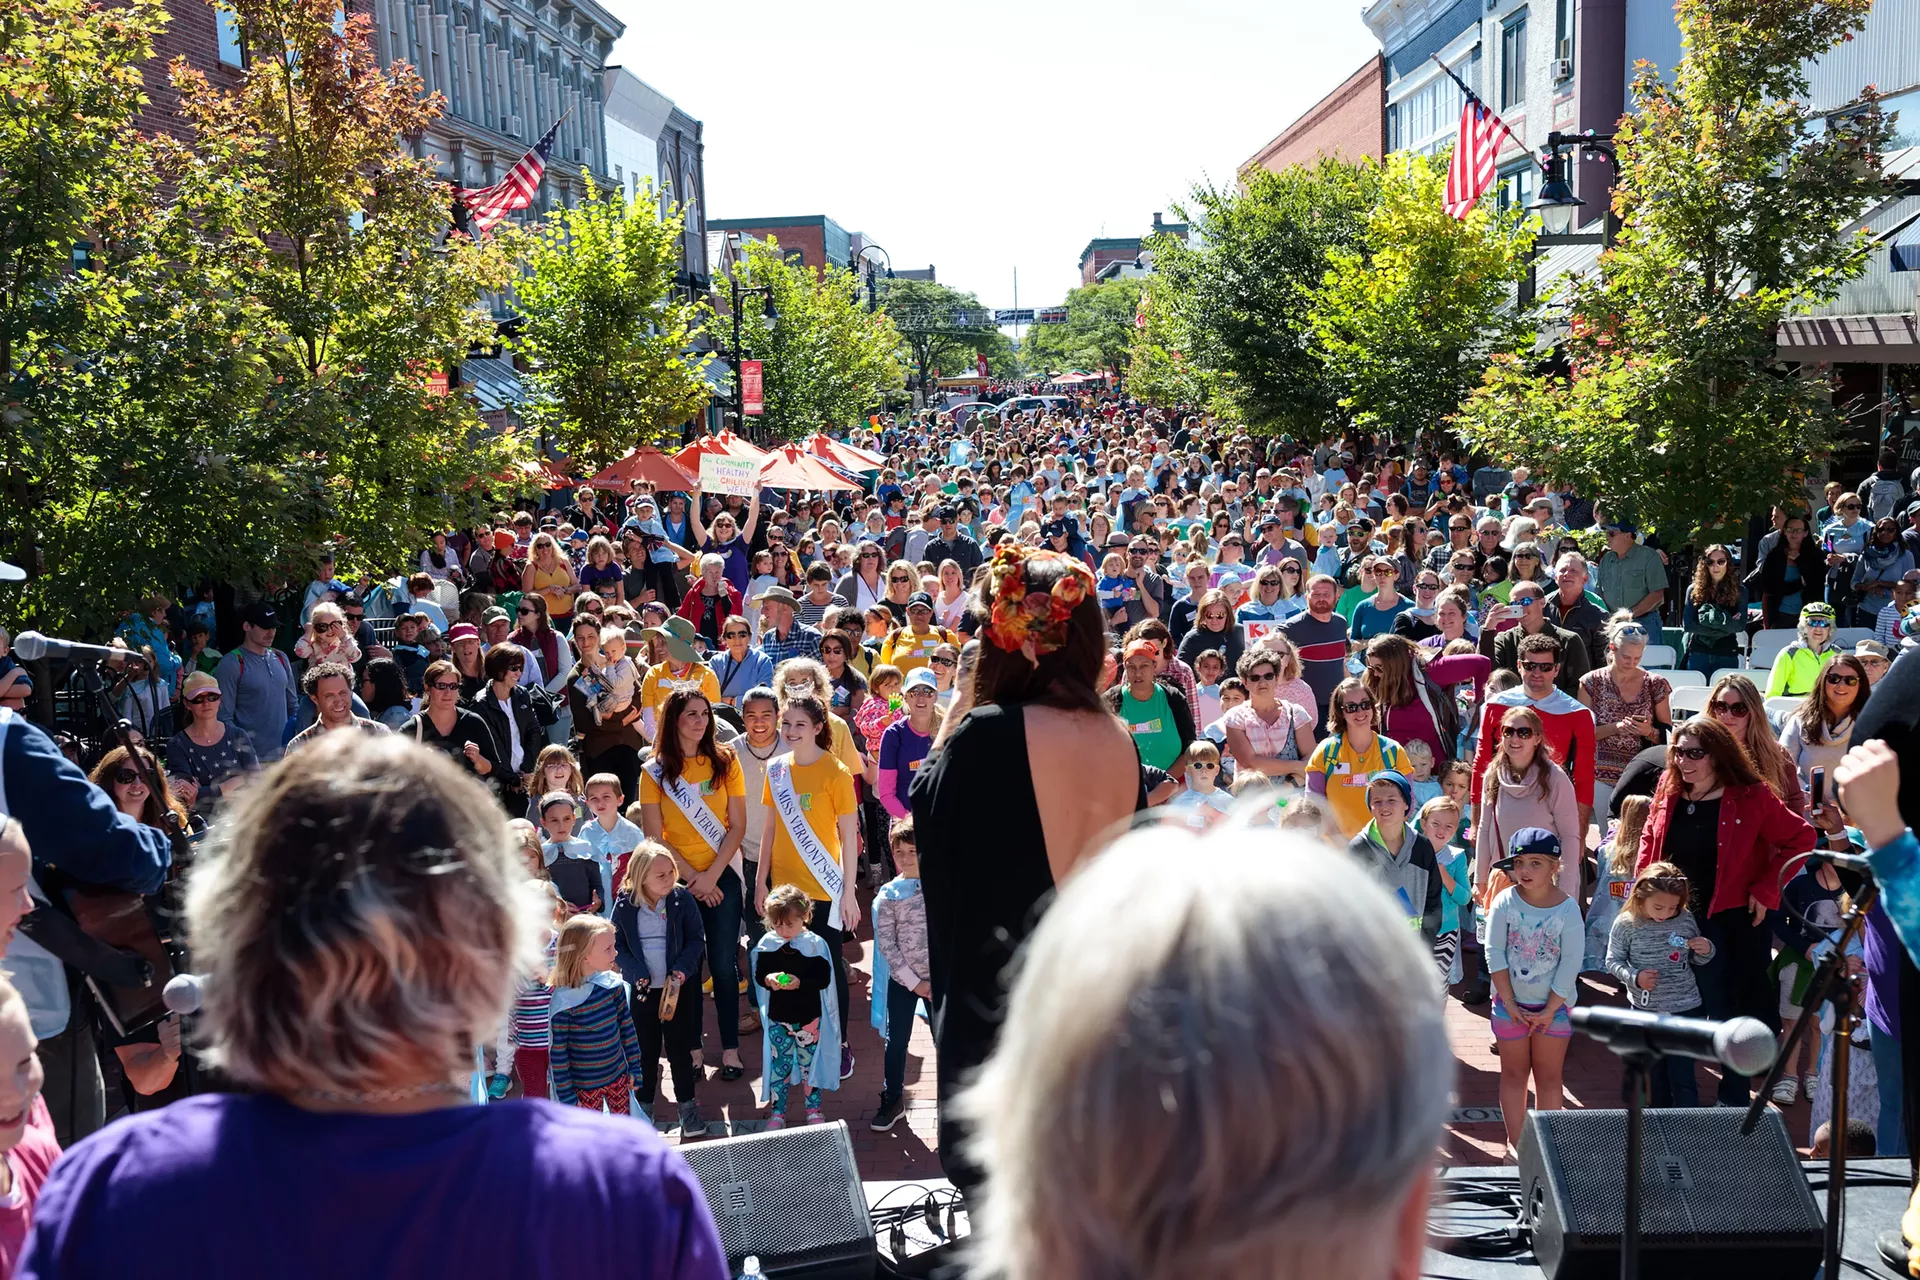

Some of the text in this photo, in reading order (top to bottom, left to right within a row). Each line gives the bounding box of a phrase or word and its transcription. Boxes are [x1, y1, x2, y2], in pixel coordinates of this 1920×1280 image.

[716, 457, 755, 470] COMMUNITY
[716, 467, 750, 478] HEALTHY
[720, 477, 757, 488] CHILDREN
[726, 485, 751, 495] WELL
[669, 781, 723, 846] MISS VERMO
[777, 788, 796, 816] MISS
[790, 815, 830, 874] VERMONT'S
[729, 1186, 747, 1210] JBL
